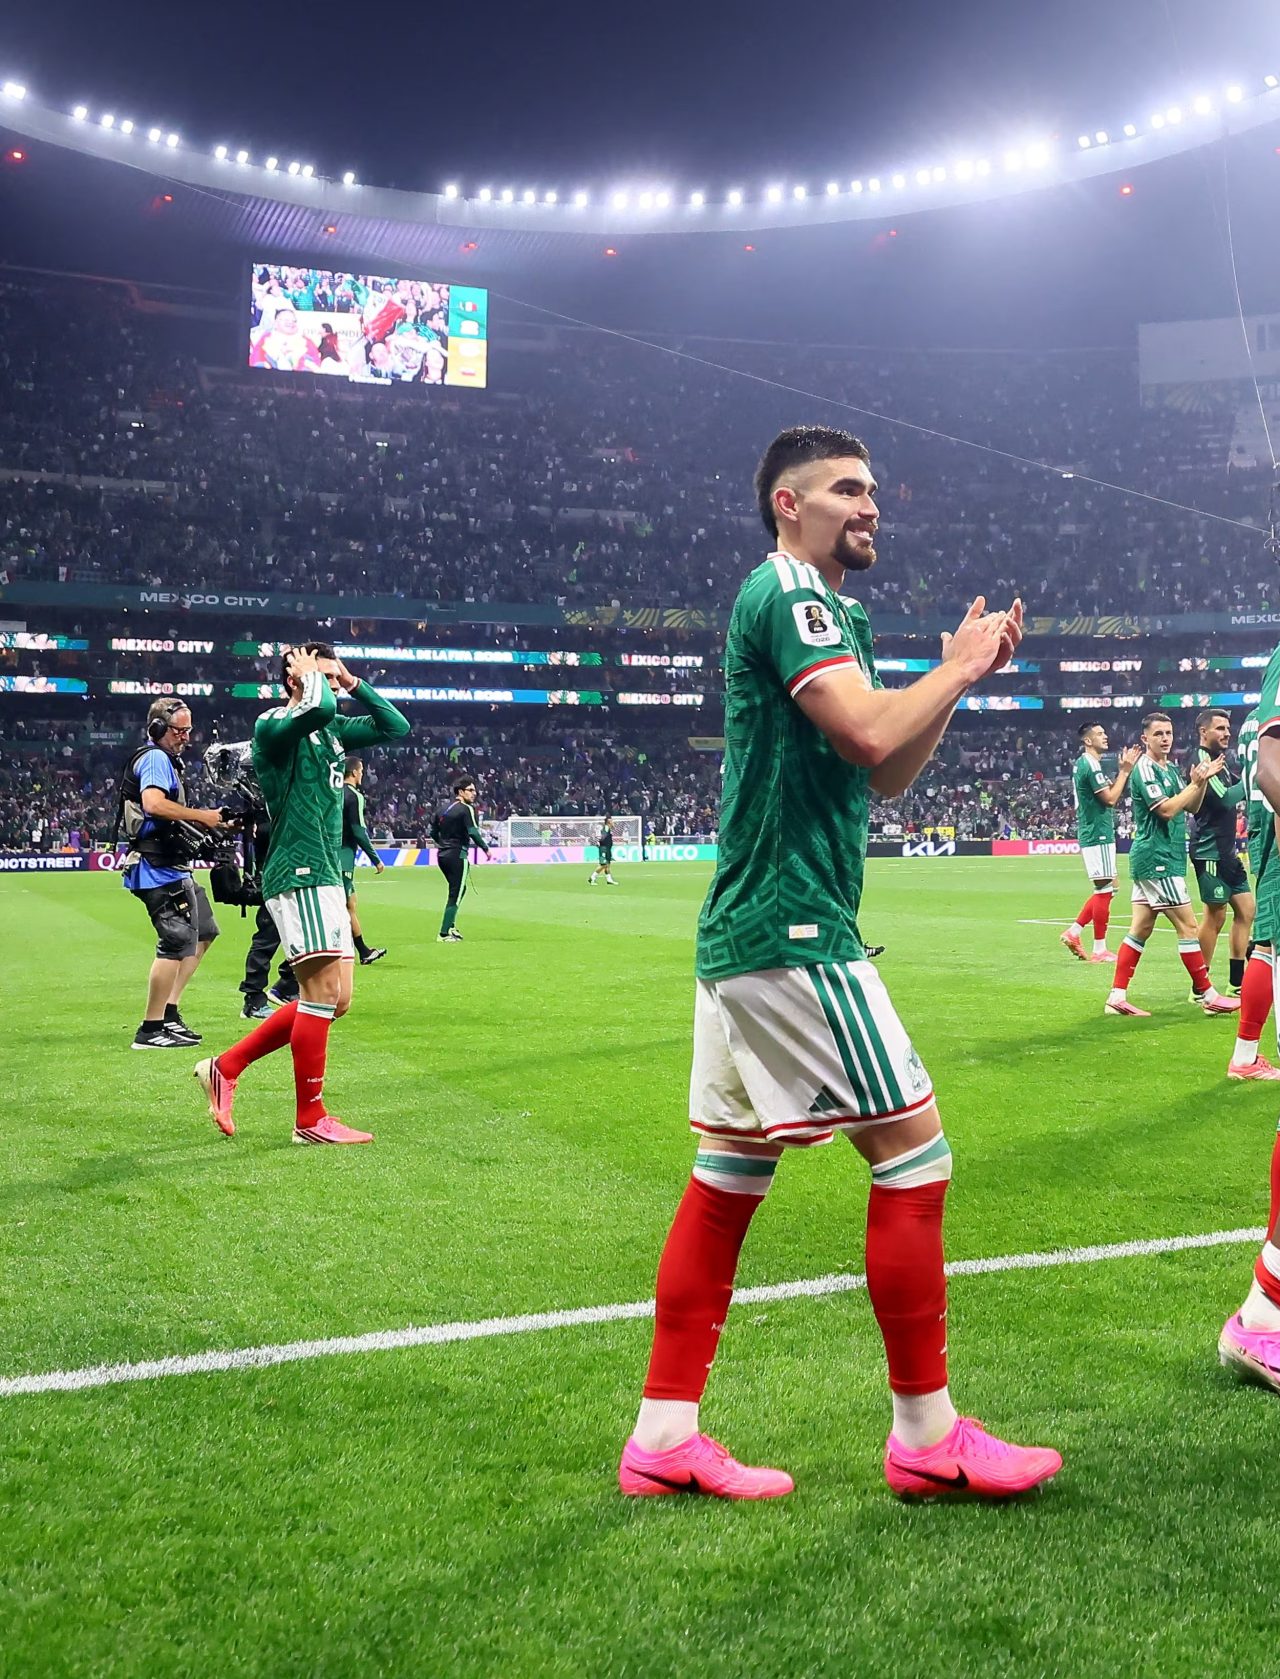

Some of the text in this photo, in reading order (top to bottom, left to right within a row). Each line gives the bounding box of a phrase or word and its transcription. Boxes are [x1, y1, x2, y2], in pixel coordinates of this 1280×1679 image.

[223, 595, 270, 608] CITY
[111, 637, 215, 654] MEXICO CITY
[416, 649, 432, 660] DE
[432, 649, 448, 661] LA
[672, 655, 703, 667] CITY
[1060, 660, 1143, 672] MEXICO CITY
[110, 680, 214, 696] MEXICO CITY
[416, 689, 432, 700] DE
[432, 689, 448, 700] LA
[617, 692, 704, 706] MEXICO CITY
[1060, 696, 1144, 709] MEXICO CITY
[613, 844, 698, 862] aramco
[902, 841, 956, 857] KIA
[1028, 841, 1080, 855] Lenovo
